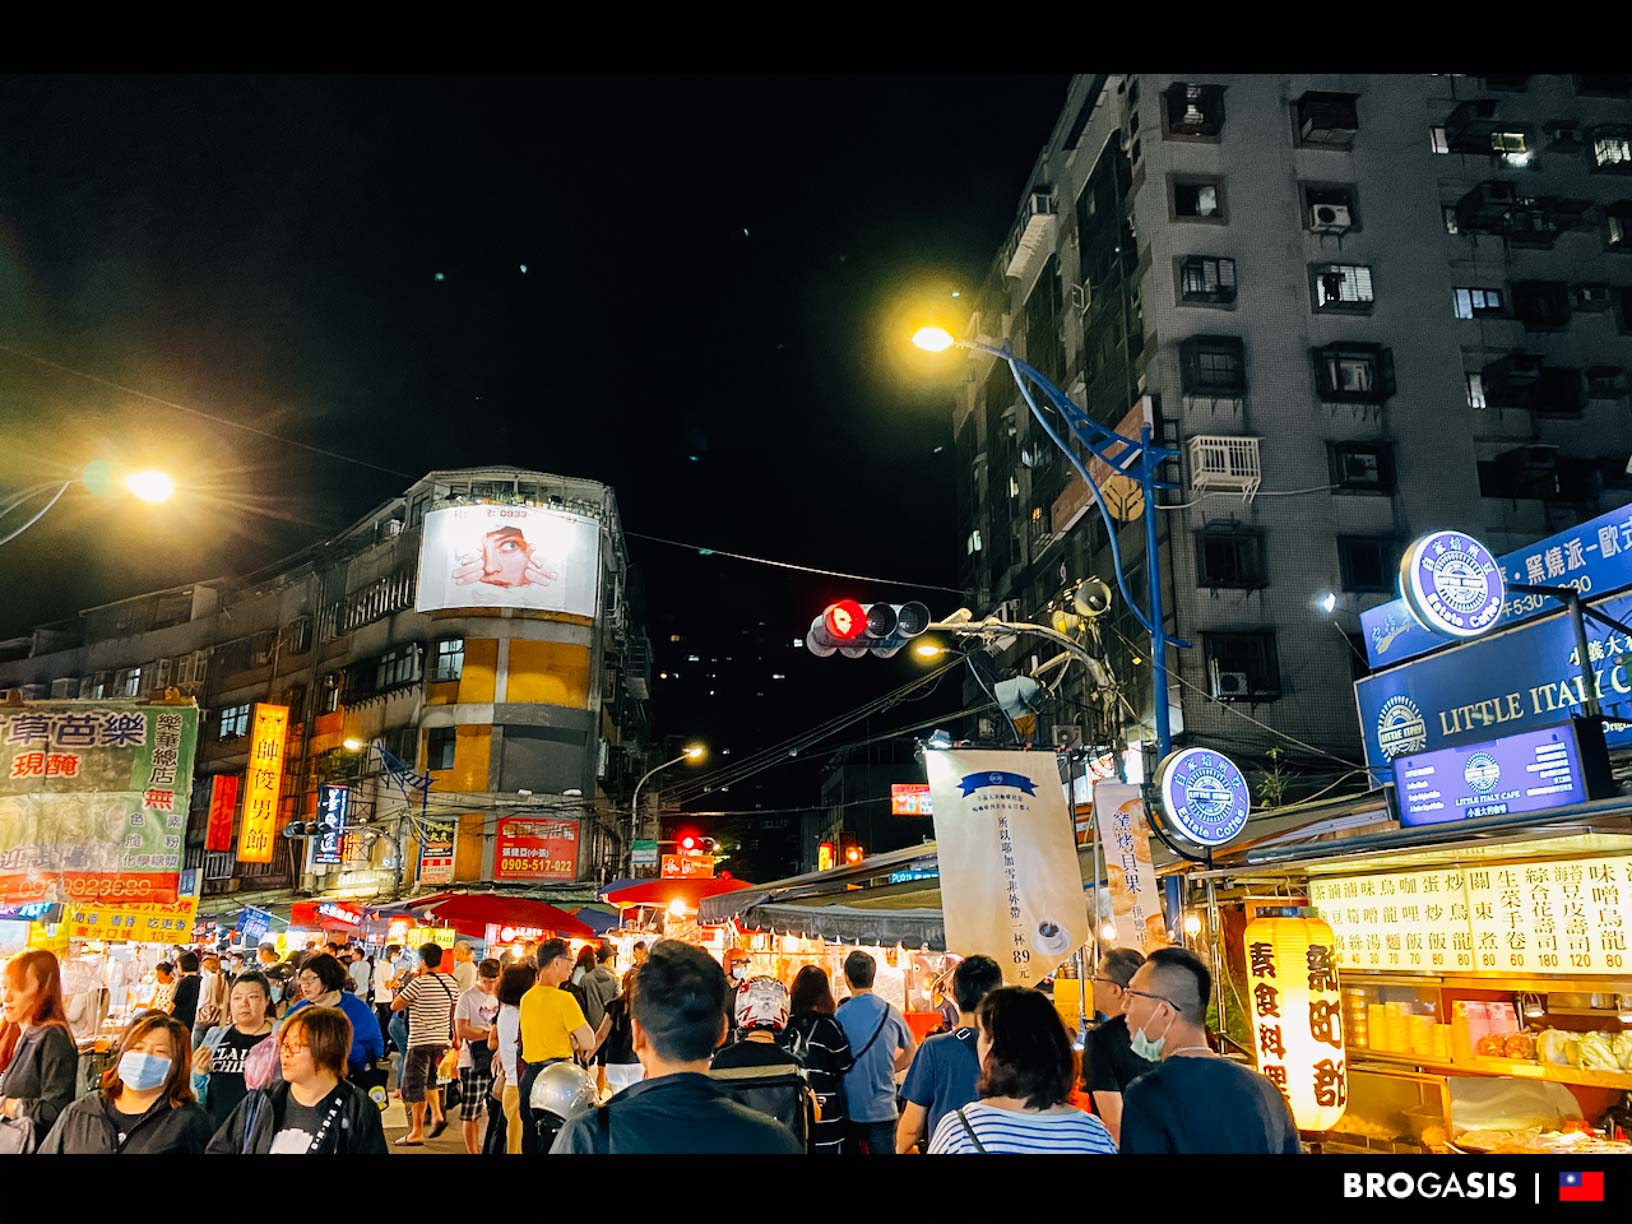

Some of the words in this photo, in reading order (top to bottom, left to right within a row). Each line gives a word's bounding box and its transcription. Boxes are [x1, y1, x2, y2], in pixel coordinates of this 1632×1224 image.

[1439, 692, 1524, 736] LITTLE
[150, 714, 182, 784] 樂華總店
[144, 789, 174, 810] 無
[1456, 797, 1479, 807] LITTLE
[1177, 807, 1210, 838] Estate
[1216, 807, 1245, 838] Coffee
[500, 859, 572, 872] 0905-517-022
[1360, 880, 1380, 951] 味噌湯
[1423, 875, 1447, 950] 蛋炒飯
[1445, 873, 1472, 951] 炒烏龍
[1590, 863, 1627, 951] 味噌烏龍
[1410, 952, 1421, 965] 70
[1432, 953, 1444, 966] 80
[1457, 953, 1470, 966] 80
[1482, 953, 1496, 966] 80
[1510, 953, 1524, 966] 60
[1538, 953, 1559, 967] 180
[1569, 954, 1591, 967] 120
[1606, 954, 1623, 967] 80
